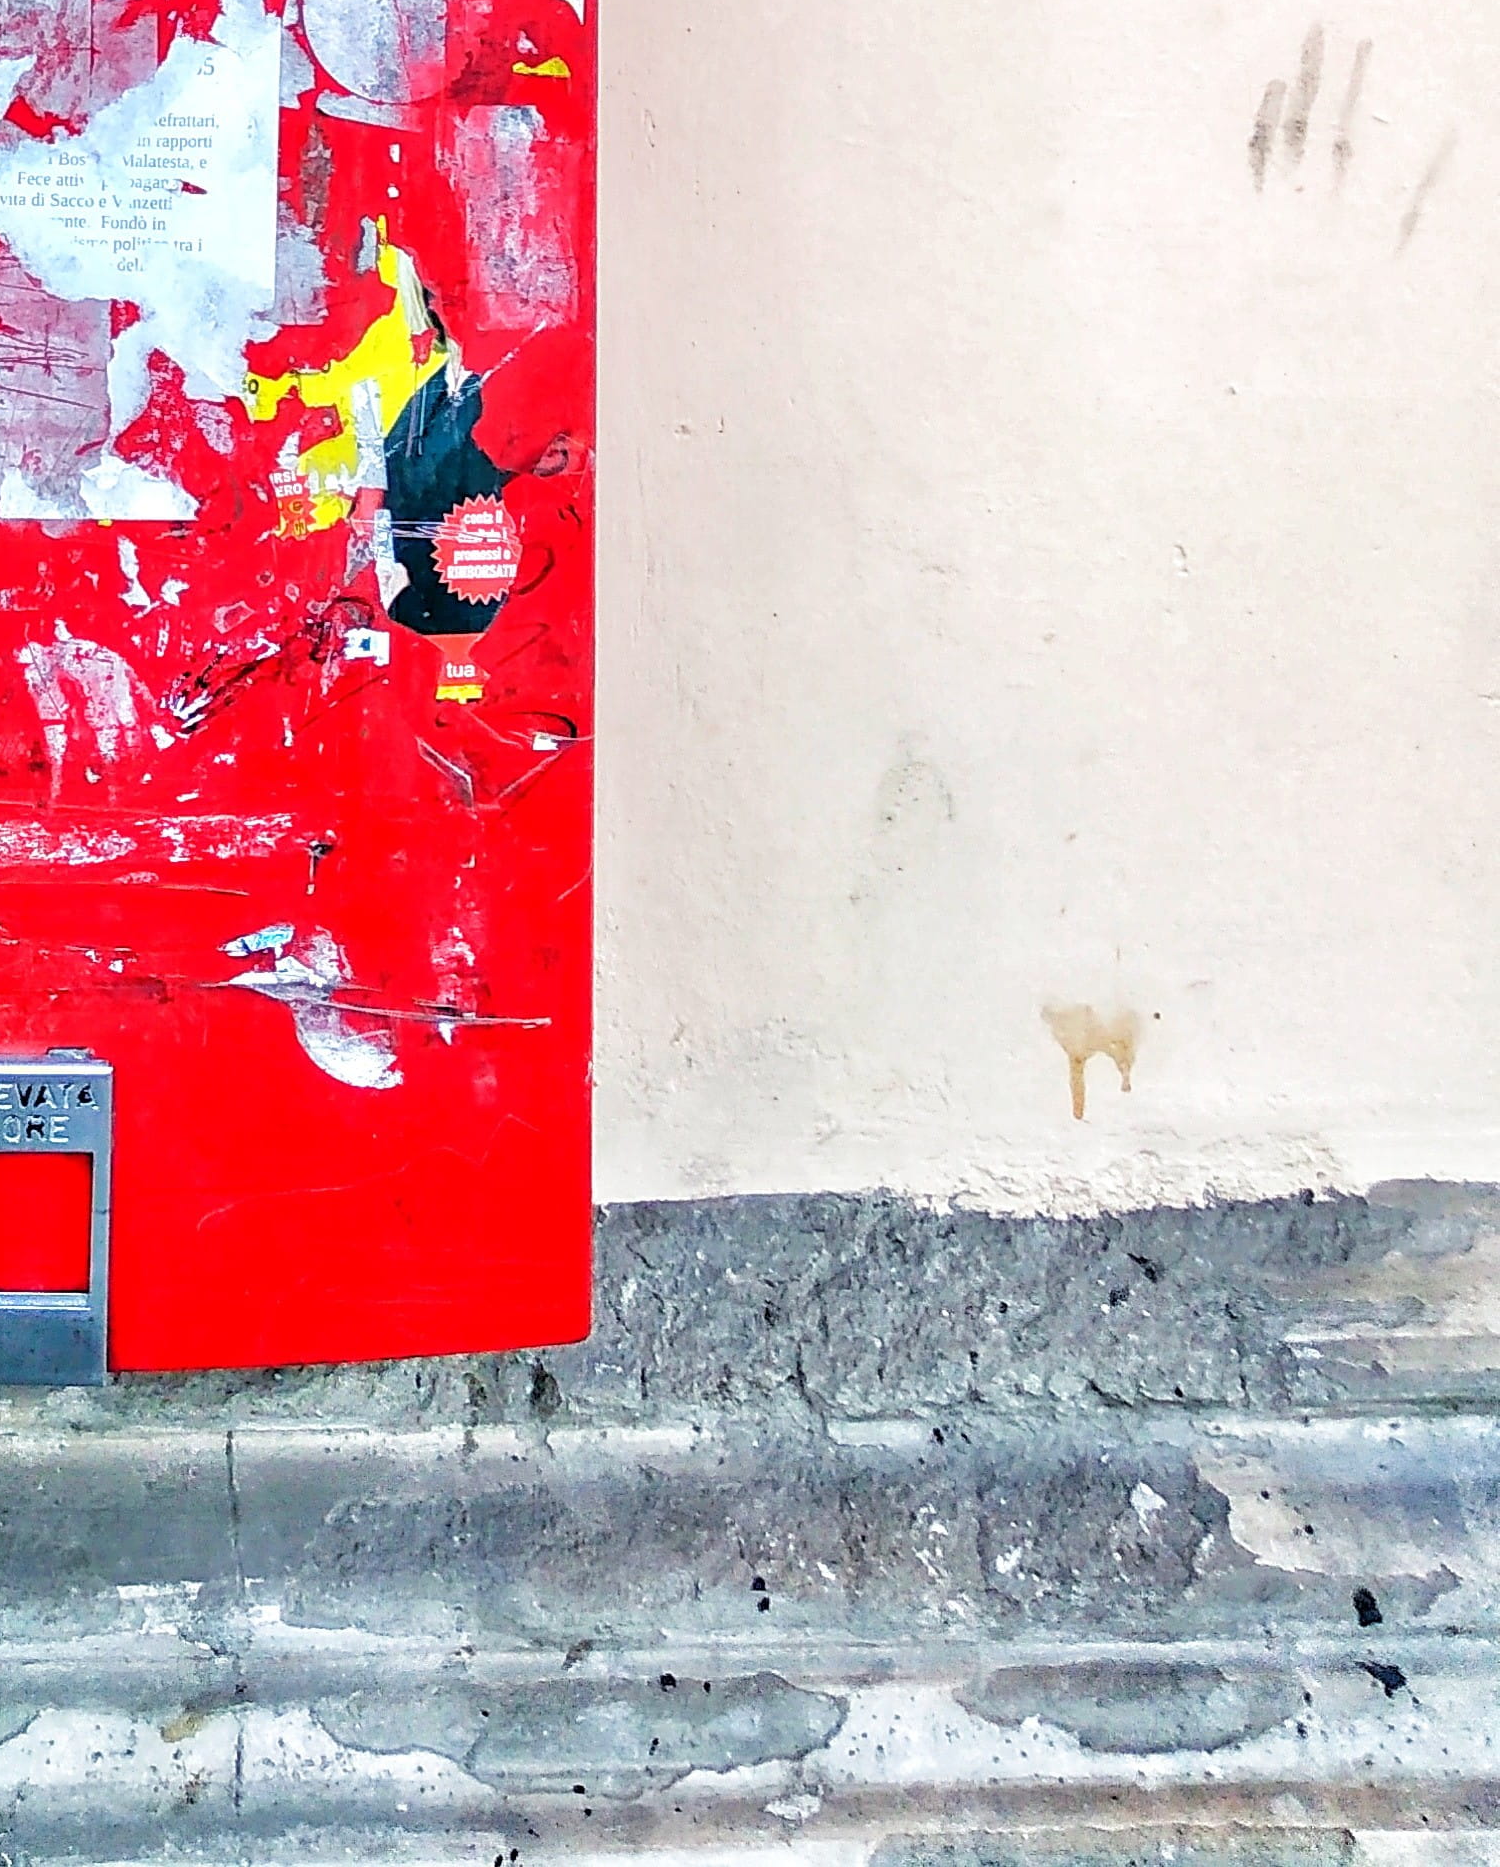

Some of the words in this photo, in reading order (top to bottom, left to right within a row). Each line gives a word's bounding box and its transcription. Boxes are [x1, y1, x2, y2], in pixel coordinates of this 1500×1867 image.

[154, 112, 220, 129] efrattari,
[156, 135, 213, 152] rapporti
[199, 158, 208, 169] e
[17, 171, 52, 187] Fece
[31, 192, 45, 208] di
[49, 193, 95, 209] Sacco
[98, 197, 107, 210] e
[112, 194, 174, 211] Vnzetti
[152, 216, 167, 231] in
[445, 662, 476, 679] tua
[2, 1114, 70, 1144] ORE
